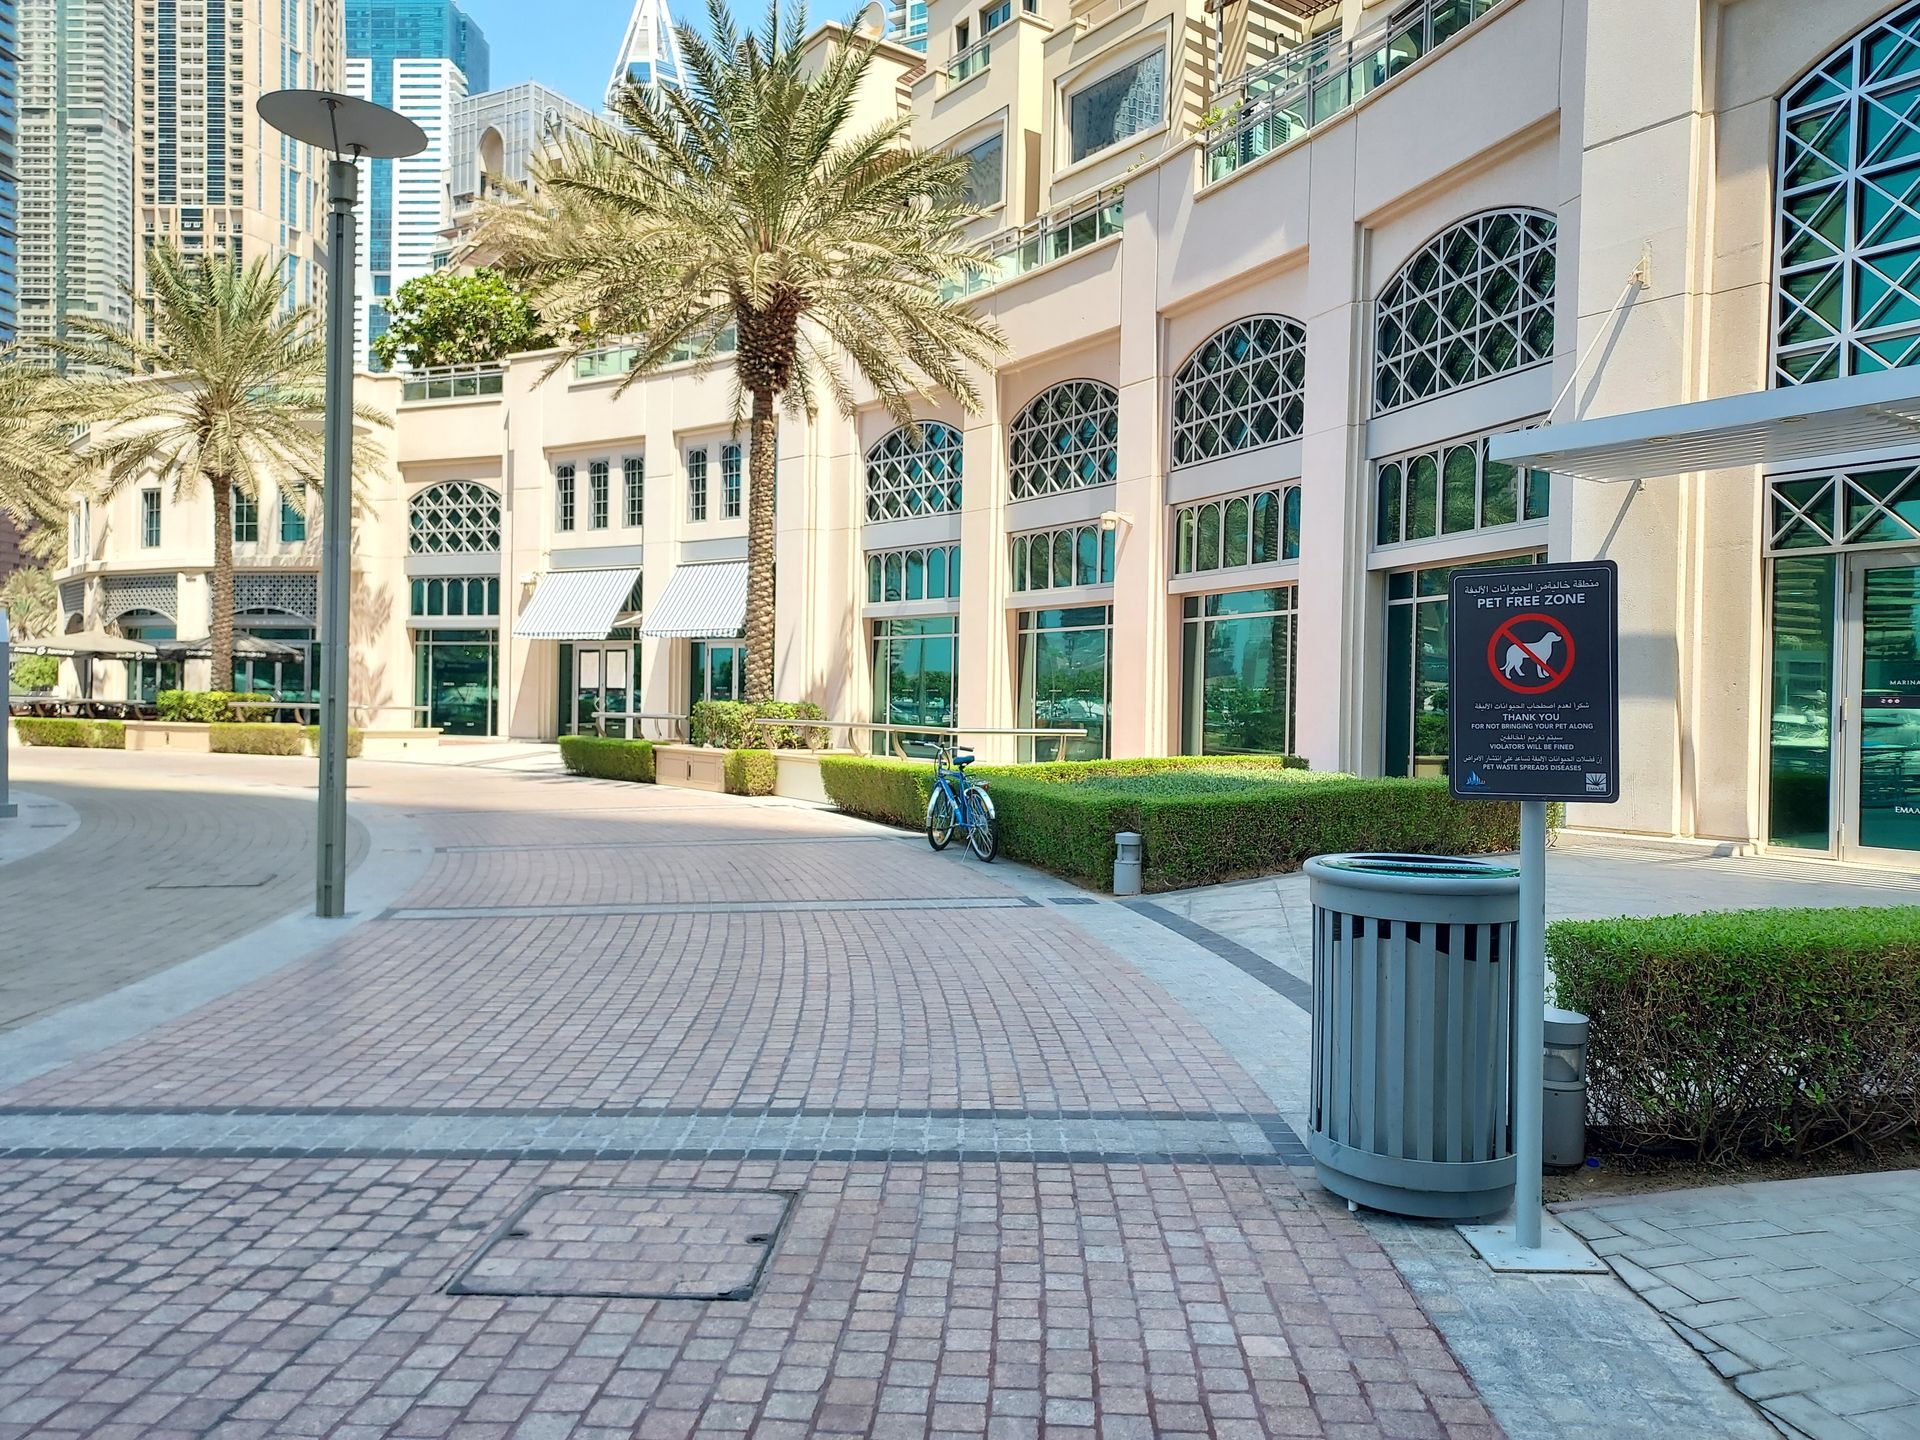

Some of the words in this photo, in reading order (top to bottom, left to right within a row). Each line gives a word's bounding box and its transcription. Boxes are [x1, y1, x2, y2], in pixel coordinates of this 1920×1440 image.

[1573, 580, 1599, 588] منطقة
[1492, 583, 1533, 594] الحيوانات
[1478, 598, 1502, 608] PET
[1506, 596, 1540, 607] FREE
[1544, 593, 1585, 605] ZONE
[1494, 702, 1525, 711] الحيوانات
[1500, 734, 1525, 742] المخالفين
[1546, 734, 1562, 742] سيتم
[1549, 756, 1574, 764] الحيوانات
